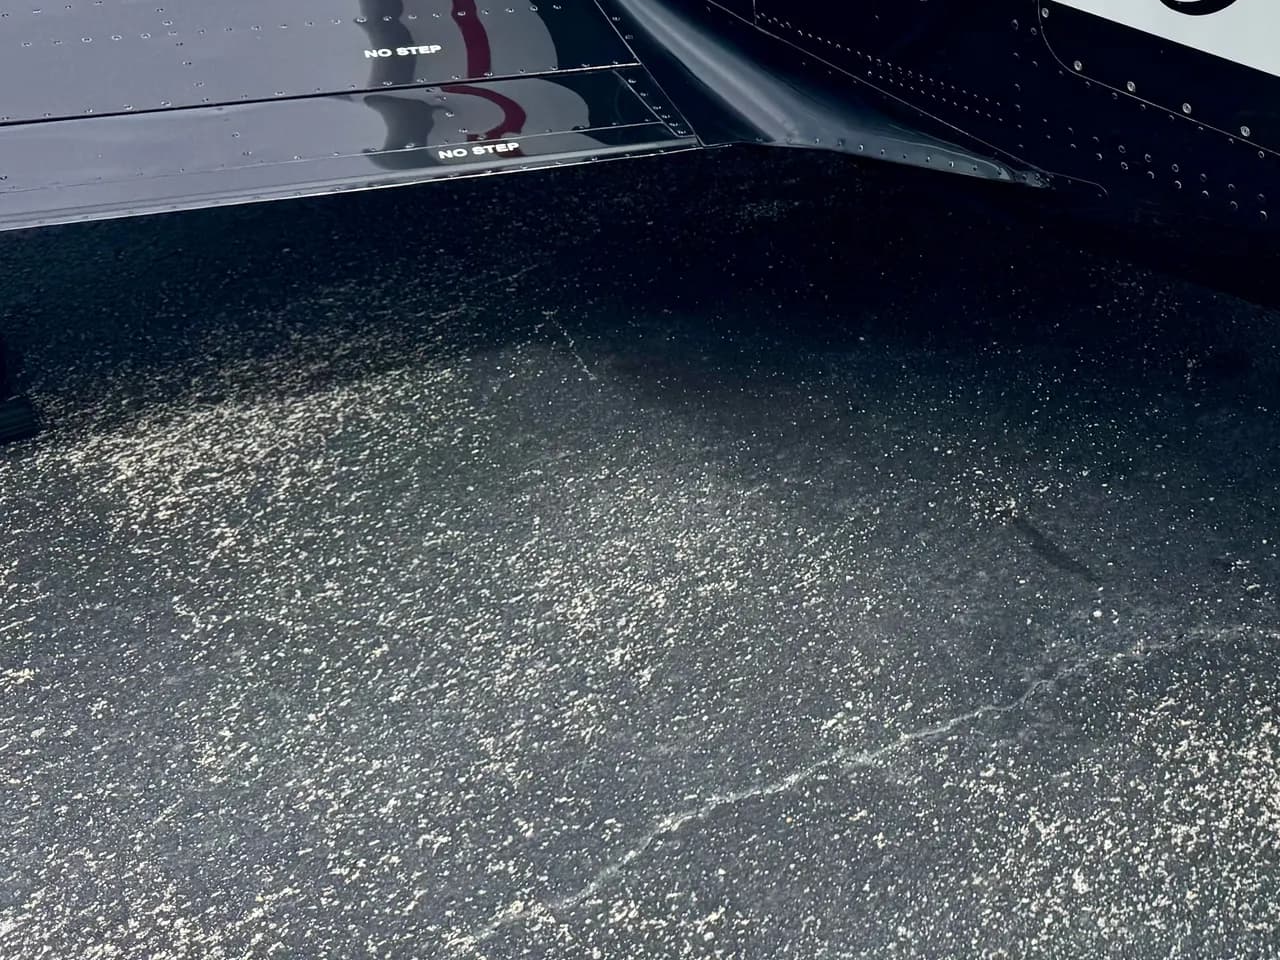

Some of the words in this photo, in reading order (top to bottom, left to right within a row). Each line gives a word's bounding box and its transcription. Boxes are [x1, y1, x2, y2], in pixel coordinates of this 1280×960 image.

[364, 48, 392, 59] NO
[396, 44, 442, 57] STEP
[438, 148, 468, 160] NO
[472, 142, 520, 156] STEP
